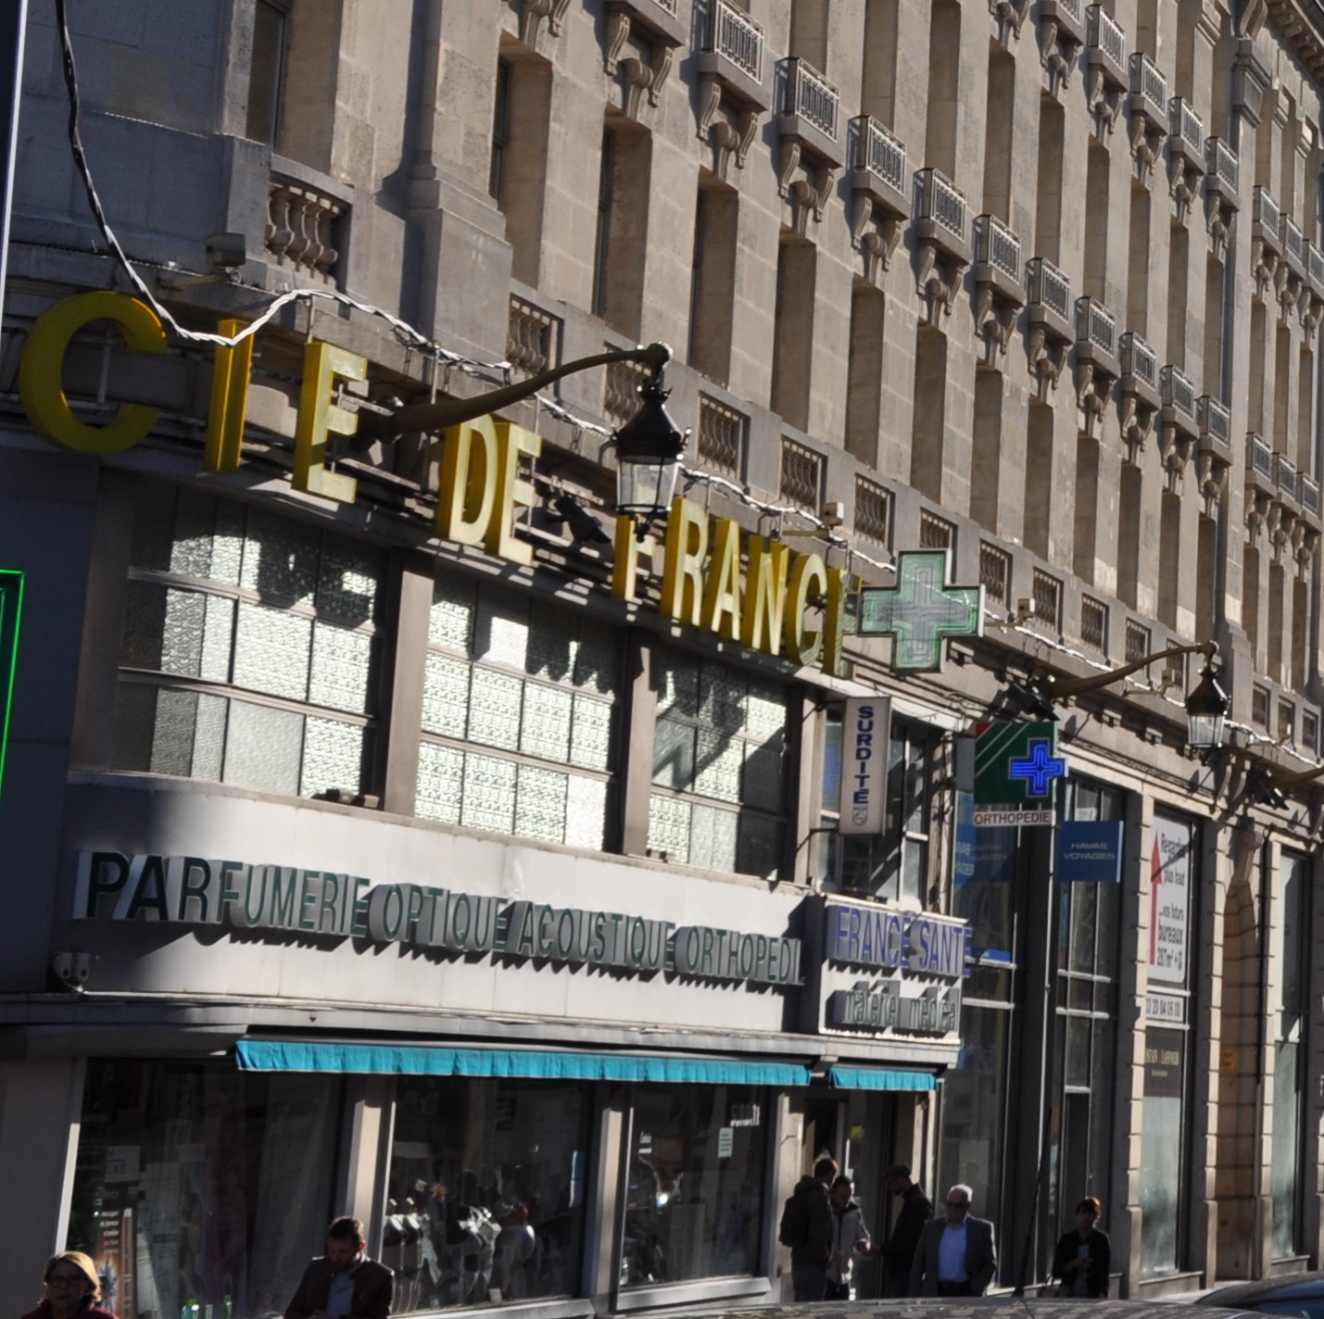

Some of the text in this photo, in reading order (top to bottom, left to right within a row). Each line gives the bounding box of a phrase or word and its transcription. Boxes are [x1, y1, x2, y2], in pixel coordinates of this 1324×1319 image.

[19, 291, 368, 504] CIE
[436, 413, 542, 566] DE
[974, 812, 1050, 825] ORTHOPEDIE
[1064, 852, 1115, 860] VOYAGES
[1071, 842, 1107, 850] HAVAS
[86, 851, 805, 986] PARFUMERIE OPTIQUE ACOUSTIQUE ORTHOPEDI
[836, 906, 911, 969] FRANCE
